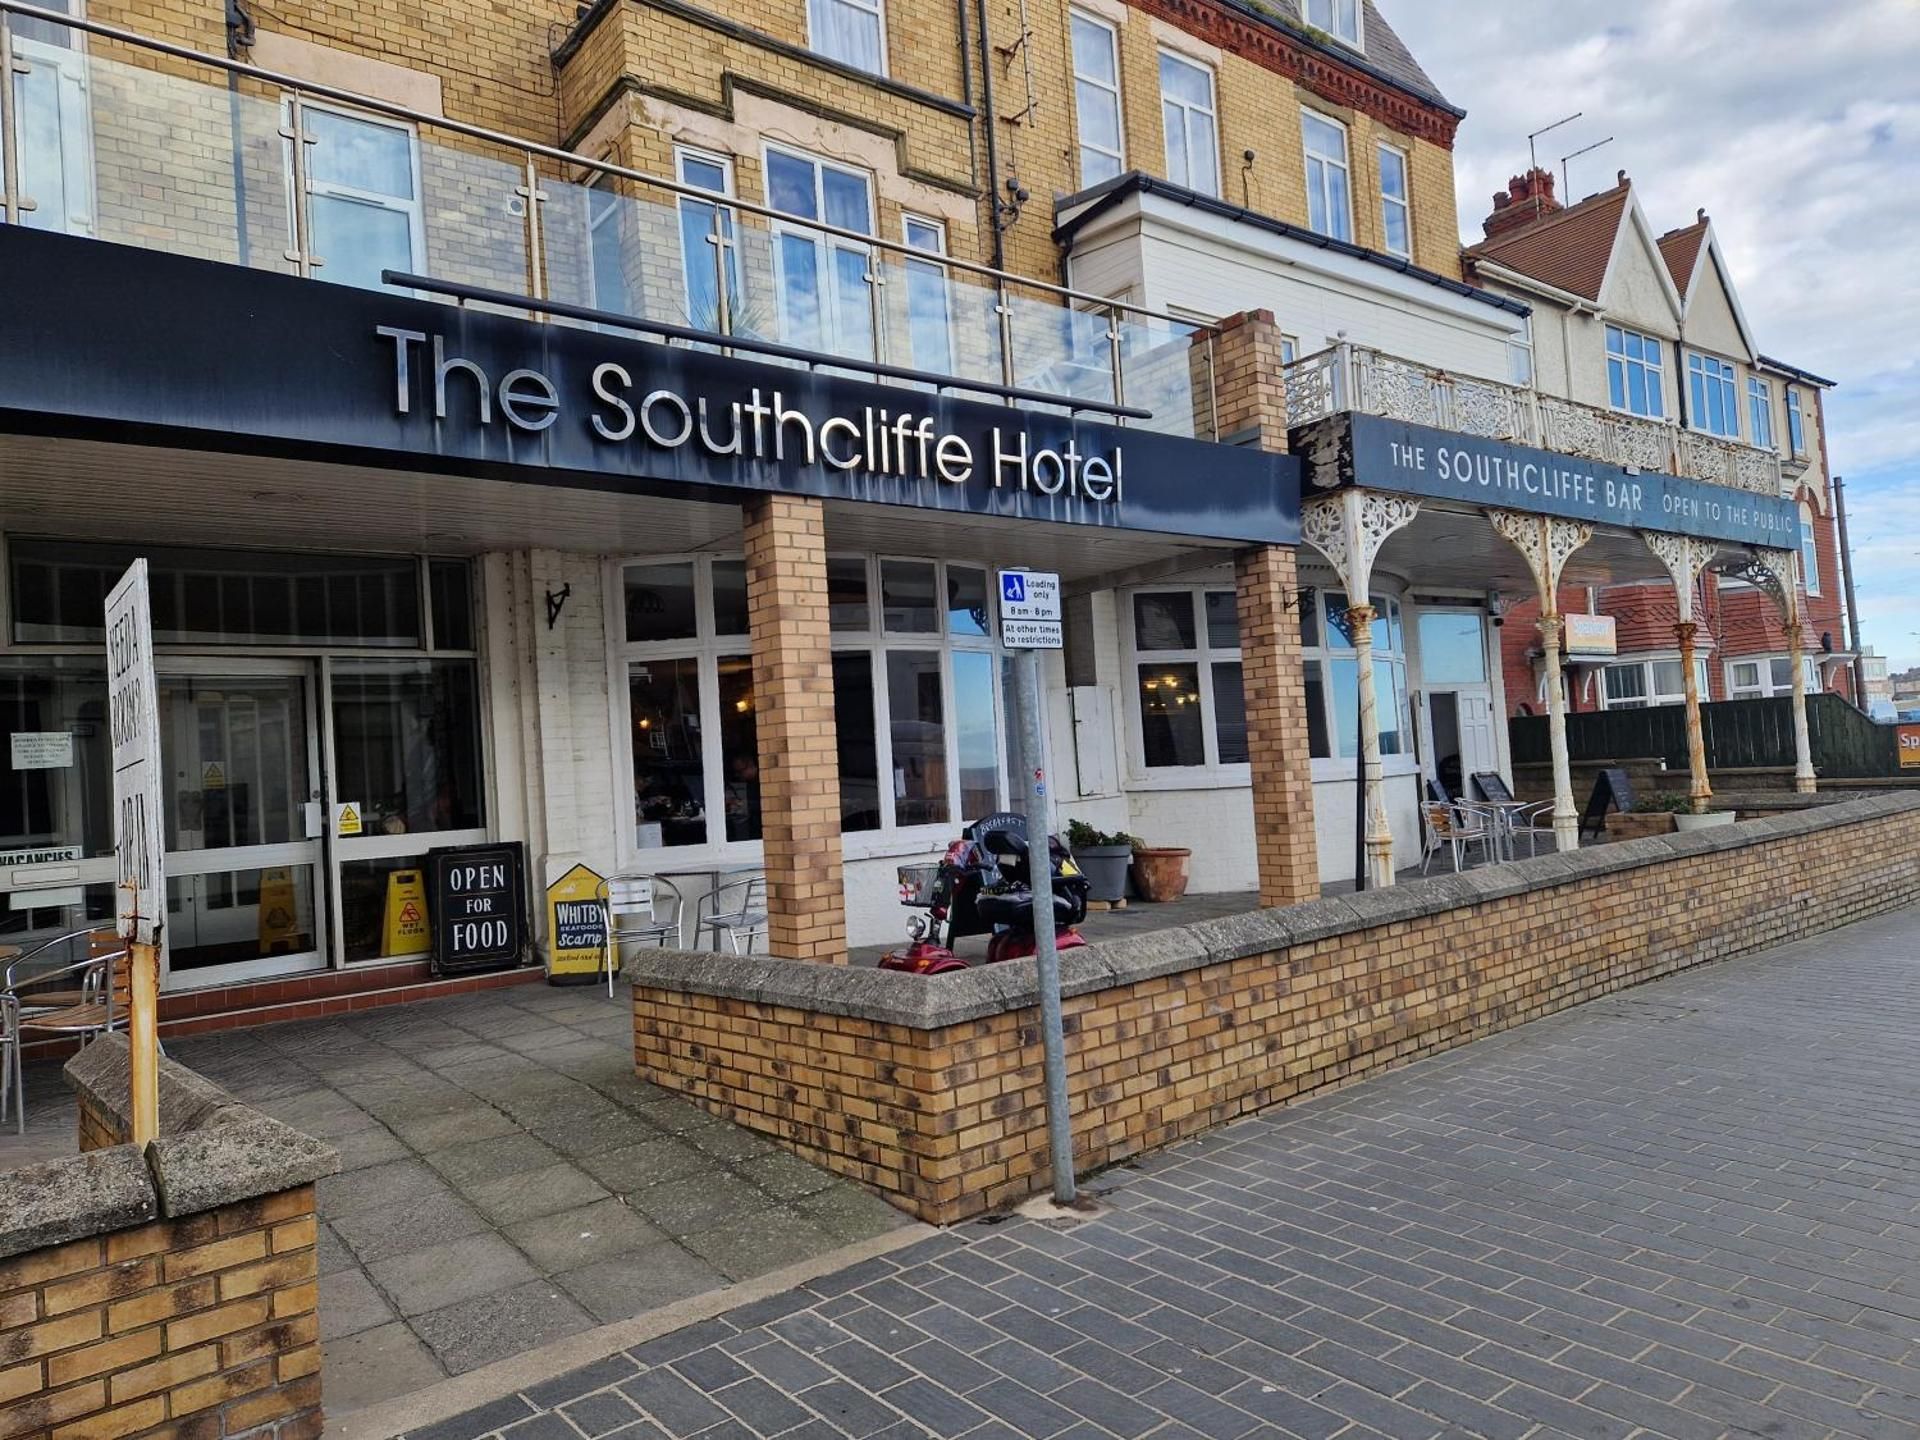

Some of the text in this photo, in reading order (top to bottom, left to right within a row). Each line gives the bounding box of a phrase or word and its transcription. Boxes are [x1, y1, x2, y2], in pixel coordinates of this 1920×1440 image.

[376, 324, 1122, 502] The Southcliffe Hotel
[1390, 442, 1793, 533] THE SOUTHCLIFFE BAR OPEN TO THE PUBLIC
[1026, 579, 1056, 590] Loading
[1033, 590, 1049, 600] only
[1005, 624, 1059, 634] At other times
[1017, 635, 1061, 644] restrictions
[450, 864, 504, 891] OPEN
[466, 898, 492, 914] FOR
[556, 903, 603, 925] WHITBY
[453, 920, 508, 950] FOOD
